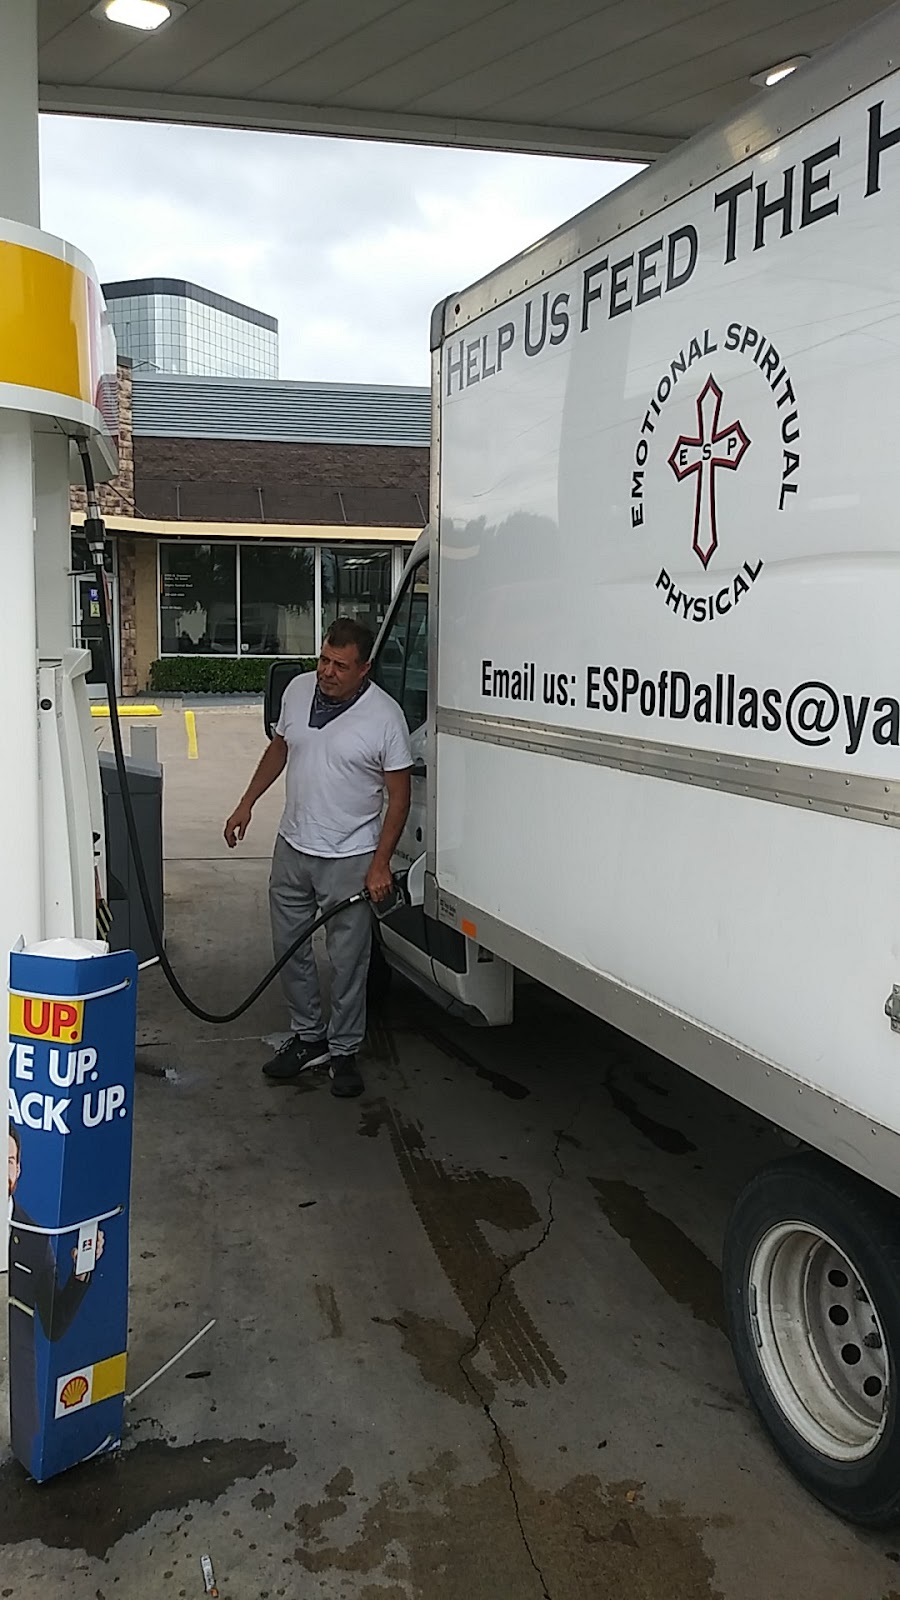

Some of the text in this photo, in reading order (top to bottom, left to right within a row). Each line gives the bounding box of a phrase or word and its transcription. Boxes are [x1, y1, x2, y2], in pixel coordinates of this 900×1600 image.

[446, 323, 516, 397] HELP
[523, 292, 572, 357] US
[579, 224, 699, 333] FEED
[714, 137, 841, 265] THE
[631, 328, 718, 529] EMOTIONAL
[724, 322, 800, 511] SPIRITUAL
[655, 558, 764, 623] PHYSICAL
[481, 660, 900, 755] Email us: ESPofDallas@ya
[23, 998, 80, 1041] UP.
[9, 1041, 99, 1088] E UP.
[82, 1084, 127, 1128] UP.
